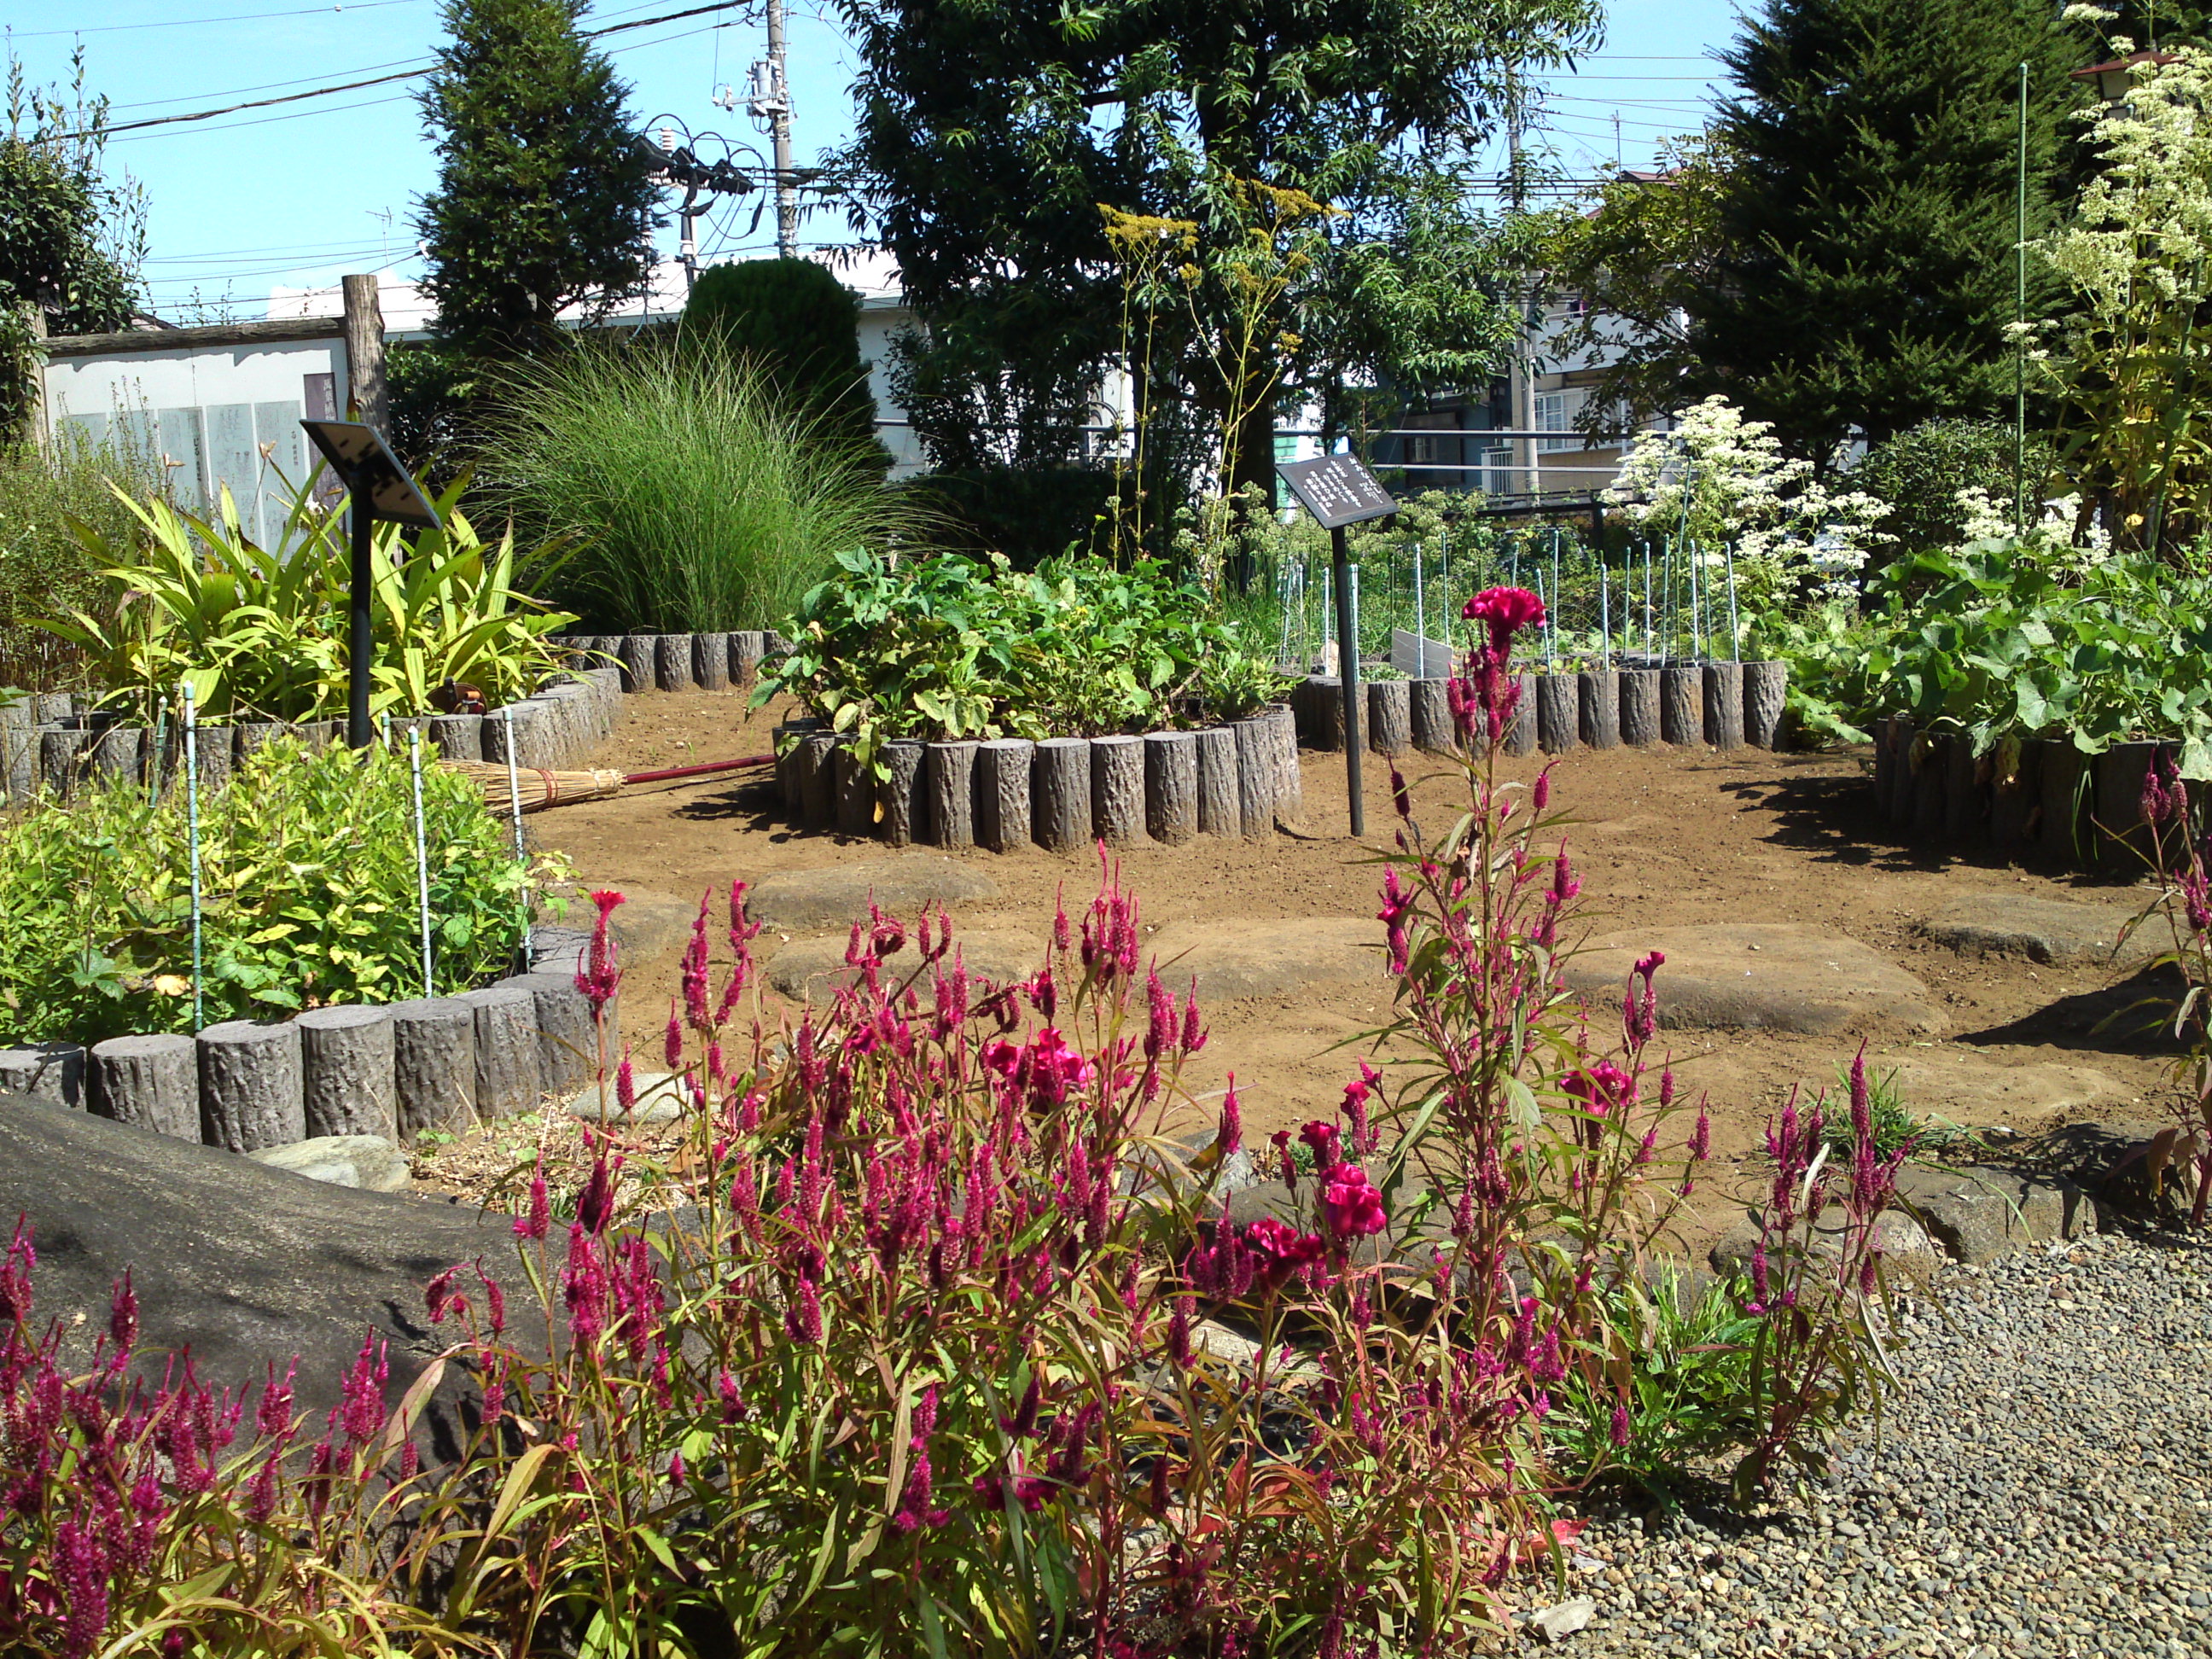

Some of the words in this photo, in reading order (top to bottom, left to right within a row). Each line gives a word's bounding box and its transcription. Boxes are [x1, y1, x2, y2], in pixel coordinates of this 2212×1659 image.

[1348, 457, 1382, 494] おみなえし
